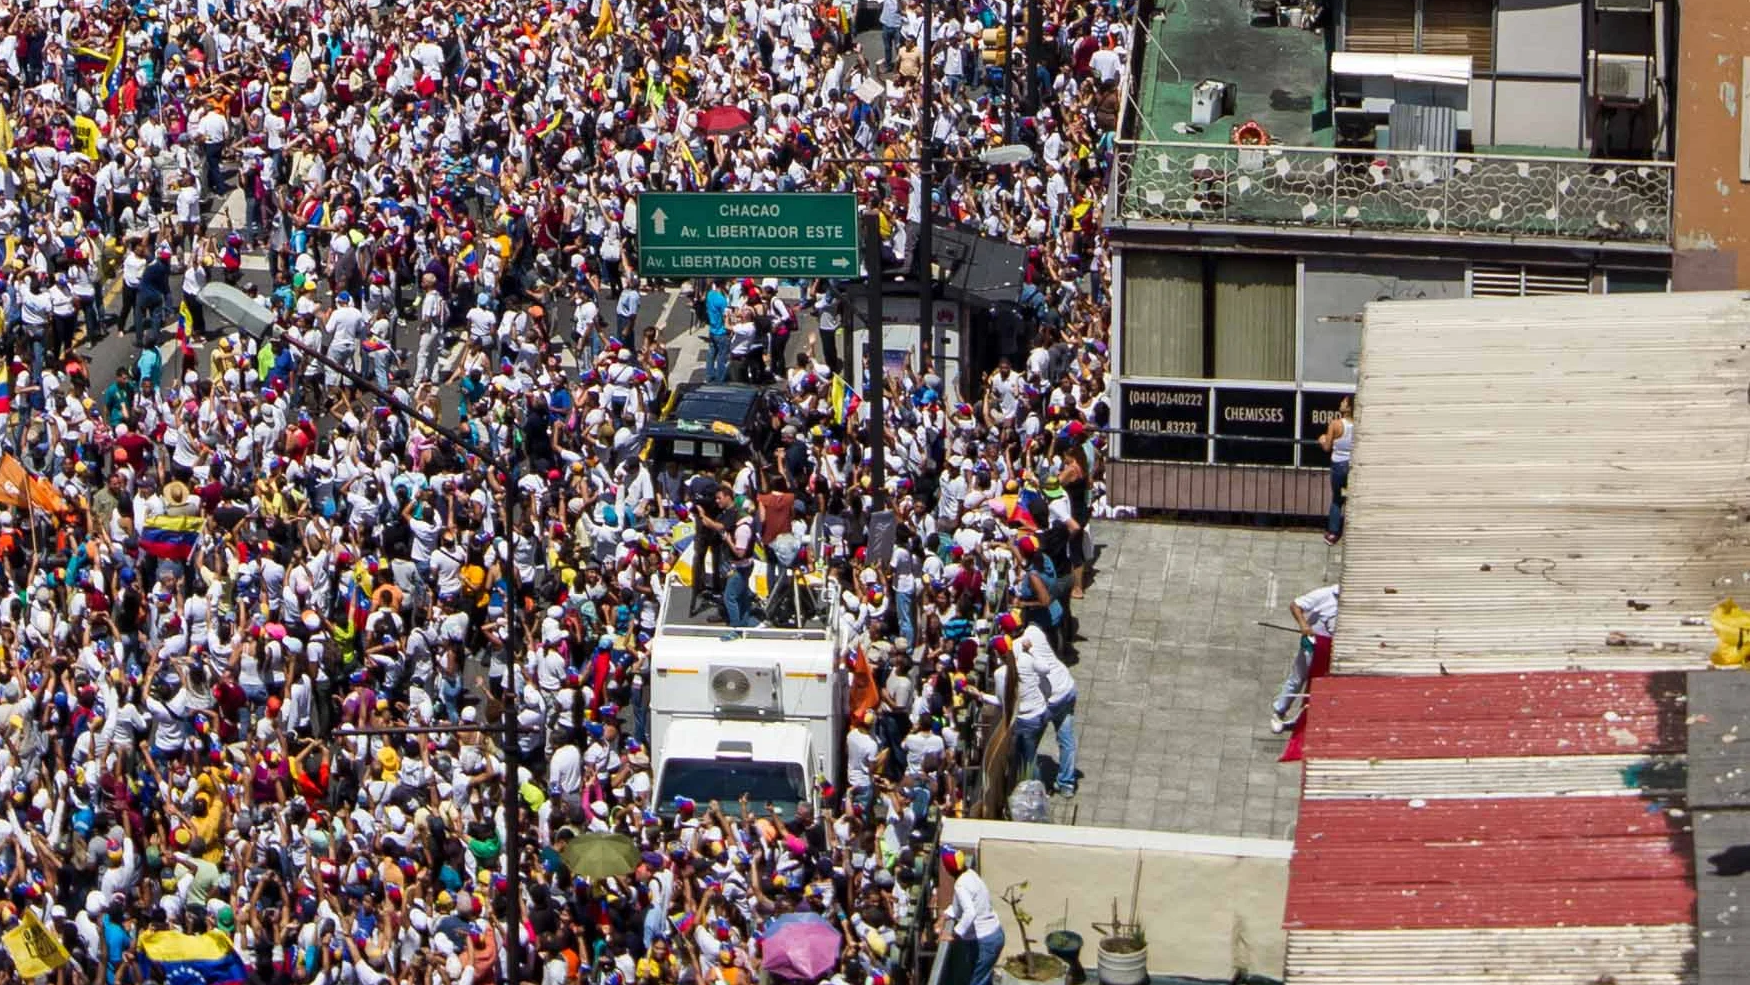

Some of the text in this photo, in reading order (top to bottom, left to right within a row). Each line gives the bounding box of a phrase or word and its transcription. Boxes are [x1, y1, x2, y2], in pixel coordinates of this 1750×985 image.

[719, 204, 780, 217] CHACAO
[680, 226, 843, 239] Av. LIBERTADOR ESTE
[646, 256, 816, 268] Av. LIBERTADOR OESTE
[1224, 406, 1284, 423] CHEMISSES
